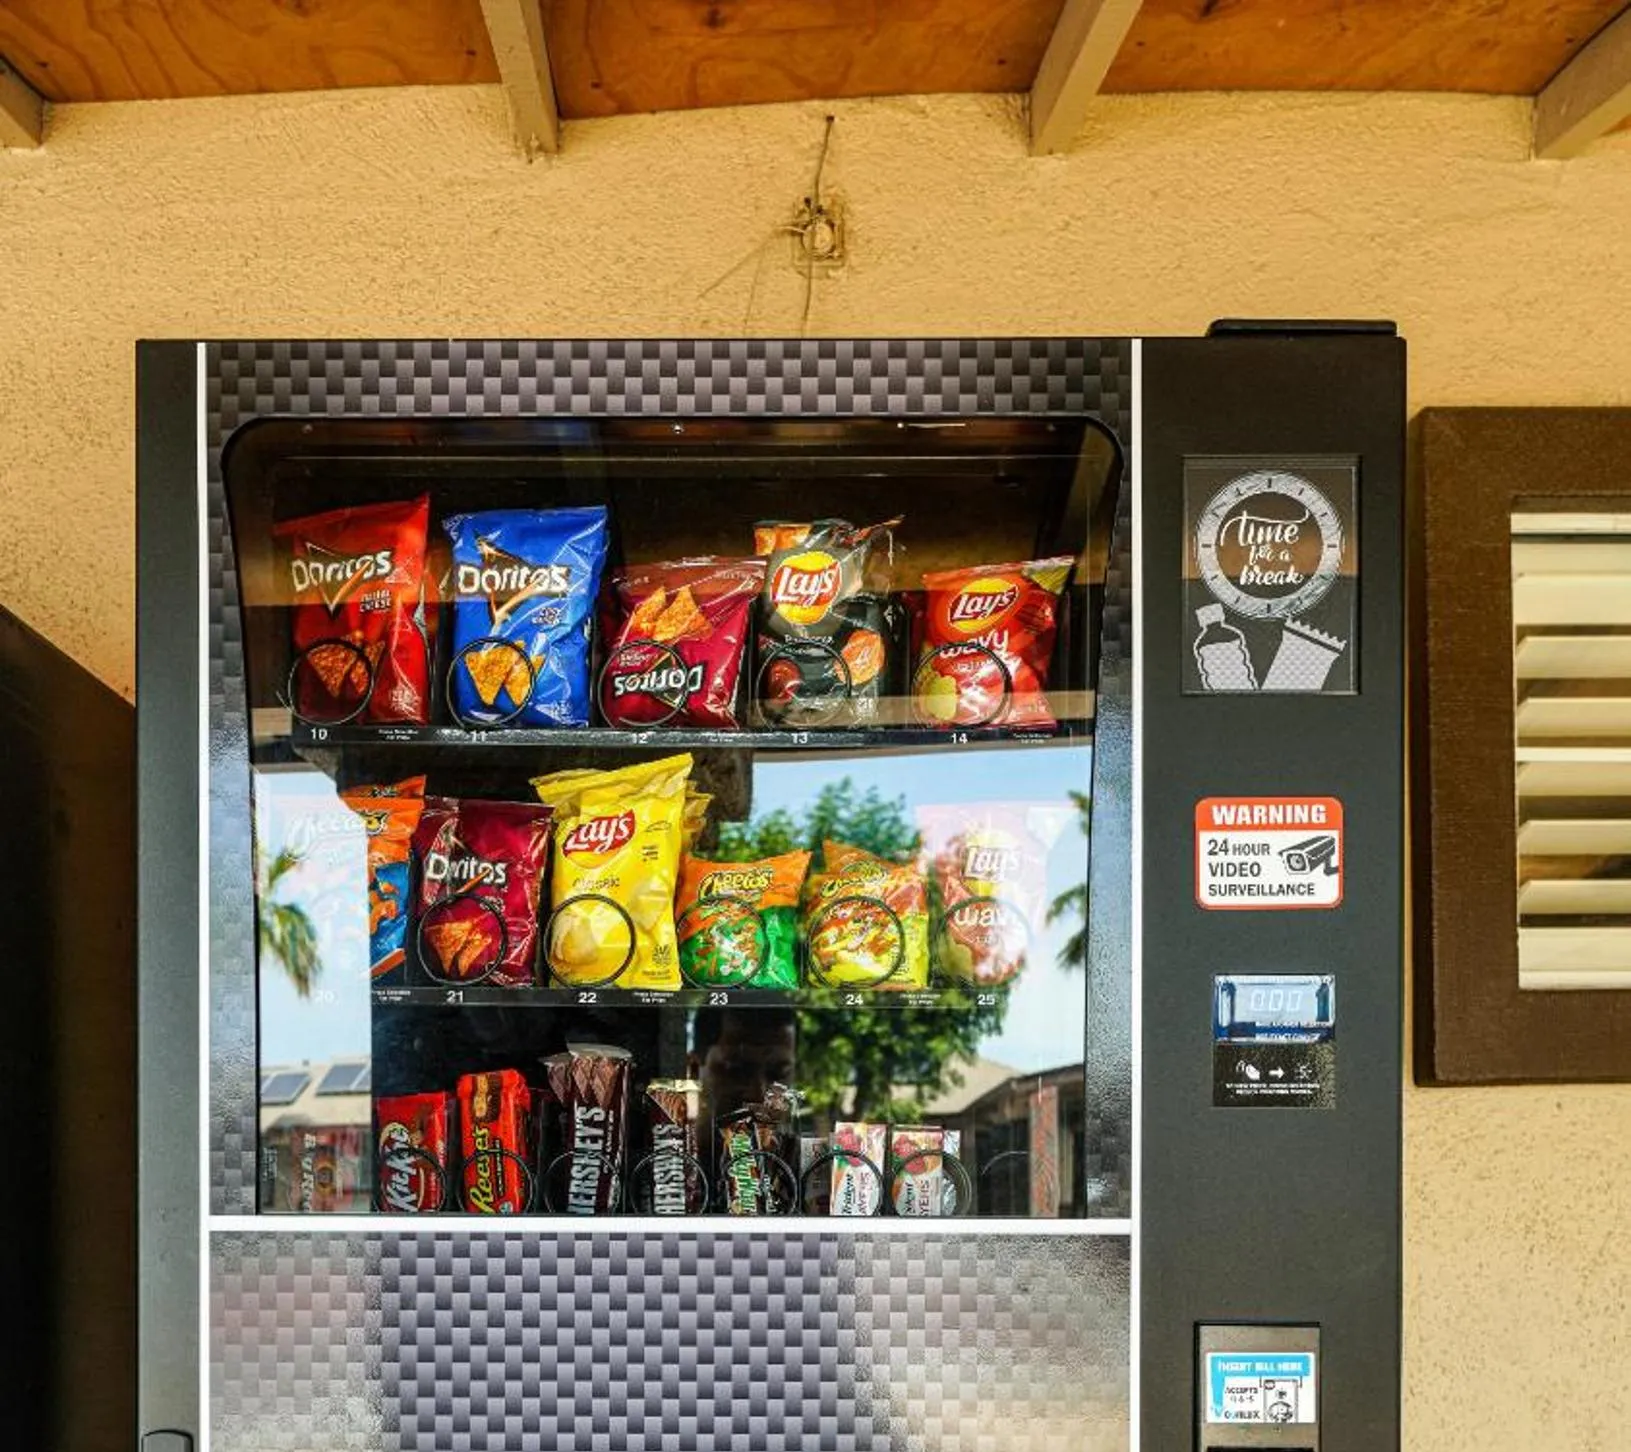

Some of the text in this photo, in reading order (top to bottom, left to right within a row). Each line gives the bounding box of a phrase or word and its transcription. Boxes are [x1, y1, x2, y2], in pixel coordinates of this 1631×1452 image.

[1220, 509, 1309, 548] Time
[292, 551, 392, 593] Doritos
[1240, 564, 1304, 586] break
[457, 564, 569, 594] Doritos
[310, 728, 329, 741] 10
[630, 733, 649, 744] 12
[790, 733, 809, 745] 13
[951, 733, 969, 745] 14
[1211, 804, 1326, 826] WARNING
[1207, 839, 1270, 857] 24 HOUR
[1208, 861, 1261, 878] VIDEO
[1208, 883, 1315, 897] SURVEILLANCE
[446, 991, 464, 1003] 21
[578, 992, 597, 1004] 22
[710, 992, 729, 1005] 23
[845, 994, 864, 1006] 24
[977, 994, 996, 1006] 25
